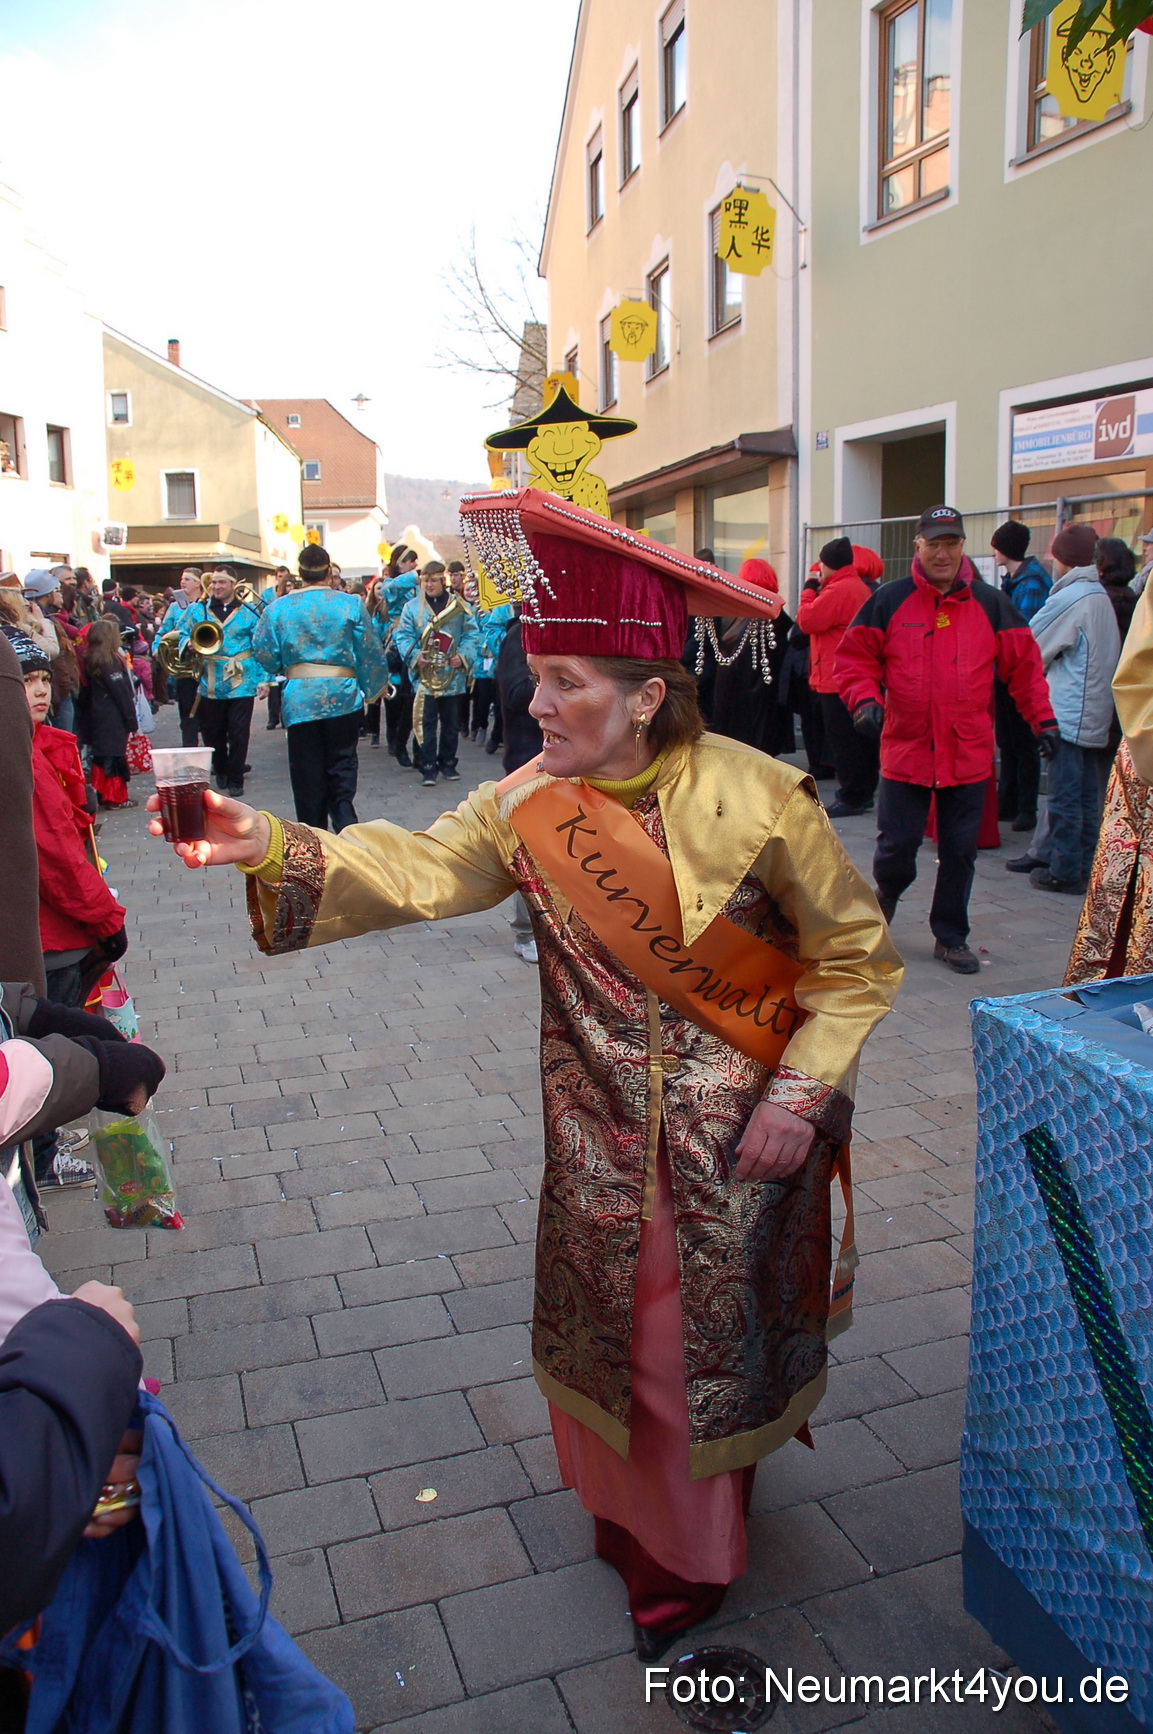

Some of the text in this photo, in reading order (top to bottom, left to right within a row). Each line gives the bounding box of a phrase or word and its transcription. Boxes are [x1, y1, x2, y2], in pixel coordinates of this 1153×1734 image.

[725, 234, 743, 260] 人
[751, 225, 771, 256] 华
[1014, 430, 1091, 451] IMMOBILIENBÜRO
[1098, 413, 1132, 443] ivd
